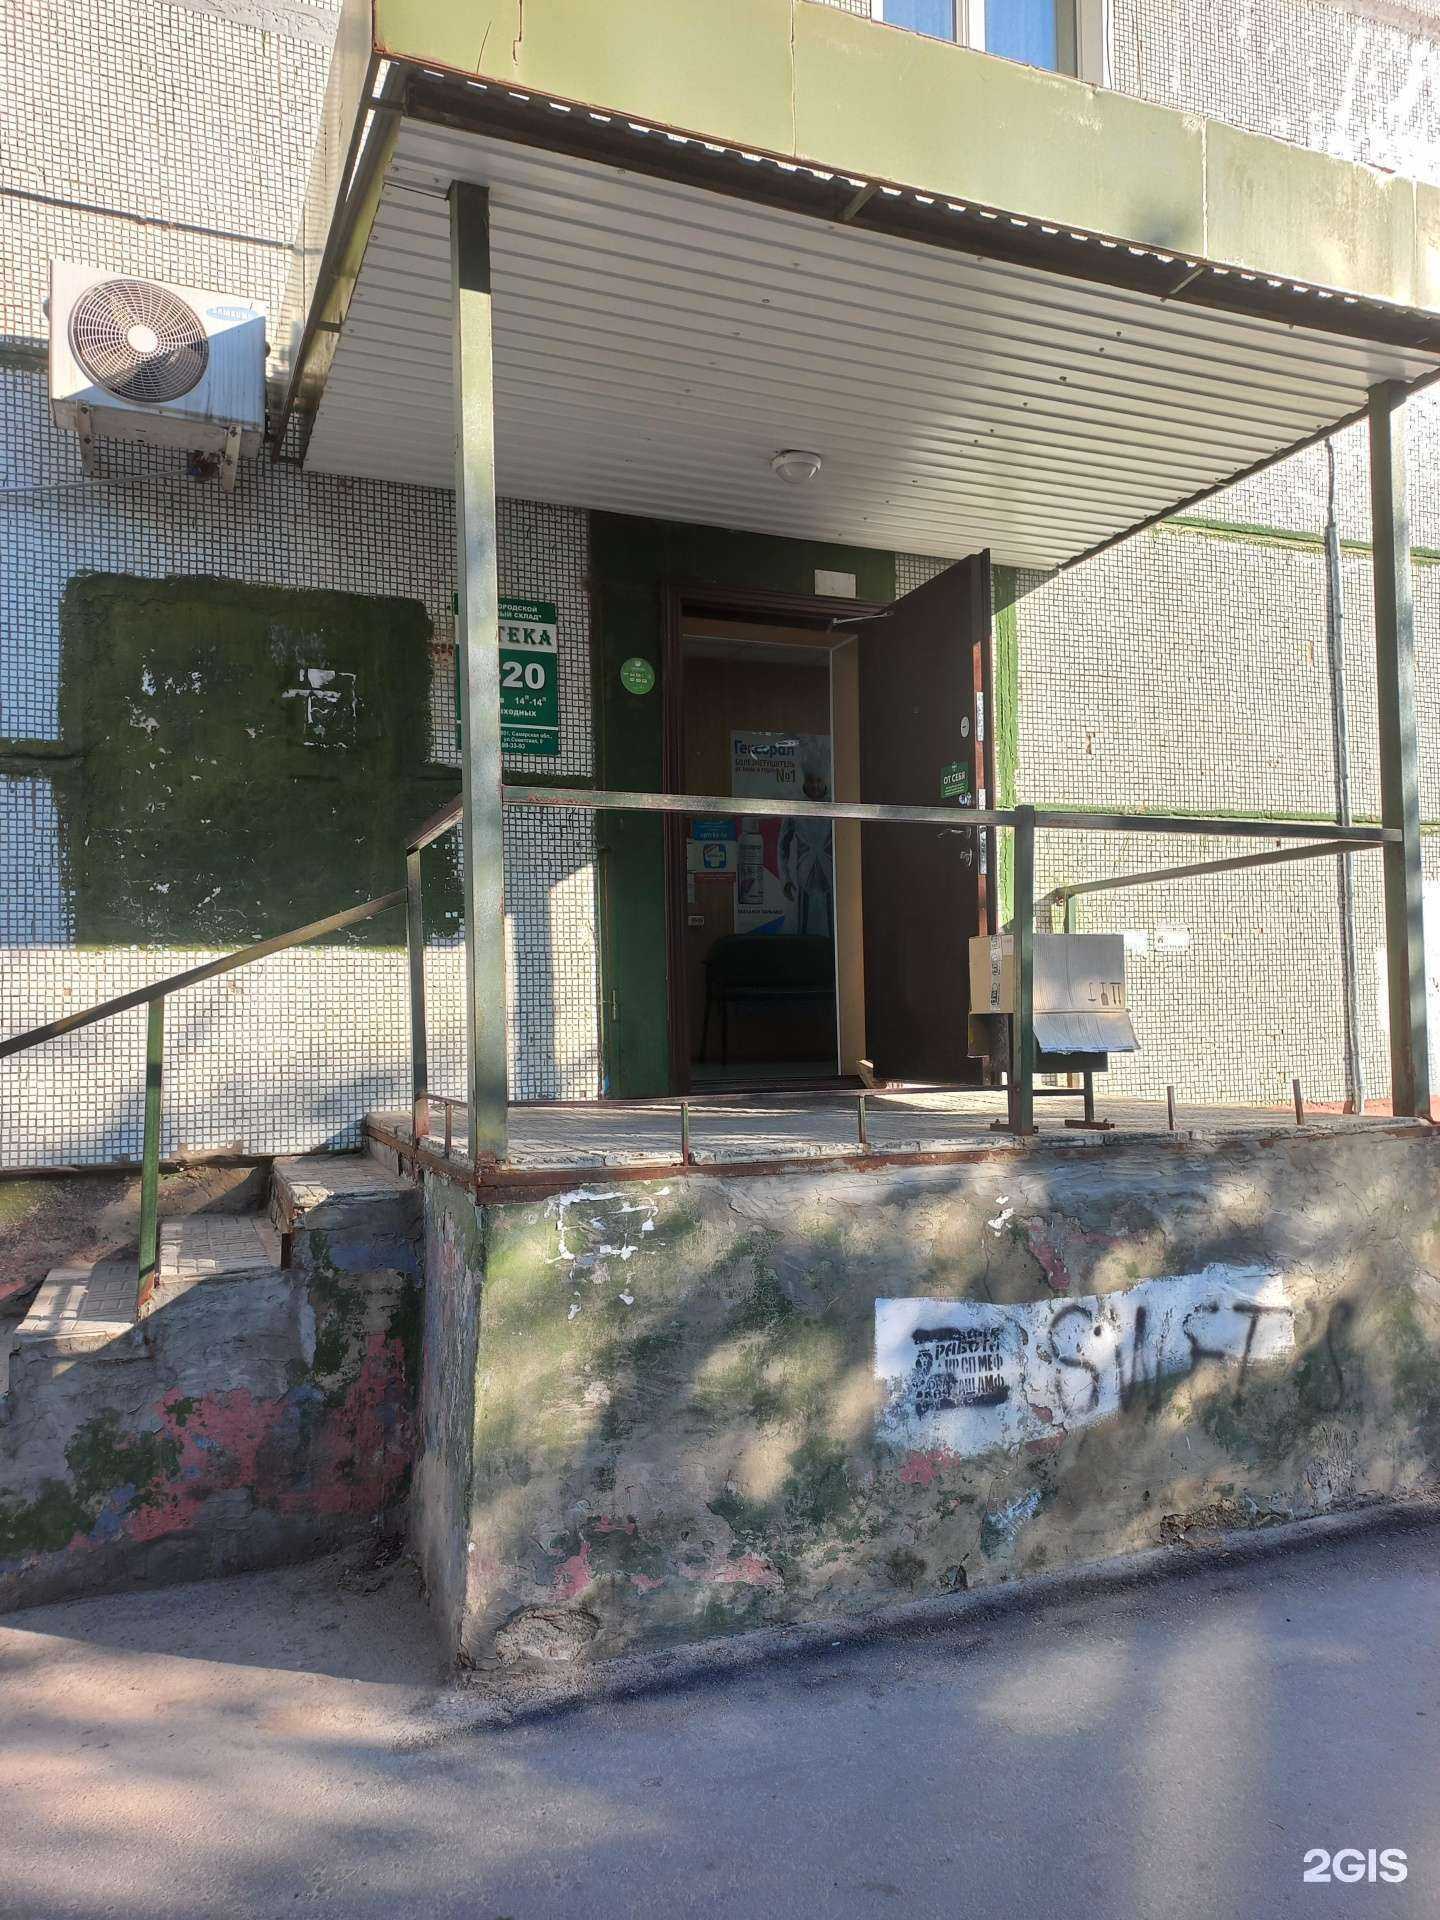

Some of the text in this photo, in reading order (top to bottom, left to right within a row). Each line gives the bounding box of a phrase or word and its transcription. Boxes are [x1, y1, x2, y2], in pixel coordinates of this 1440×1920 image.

[498, 604, 538, 613] ОРОДСКОЙ
[498, 626, 552, 646] ТЕКА
[501, 708, 537, 717] ХОДНЫХ
[943, 771, 966, 784] ОТ СЕБЯ
